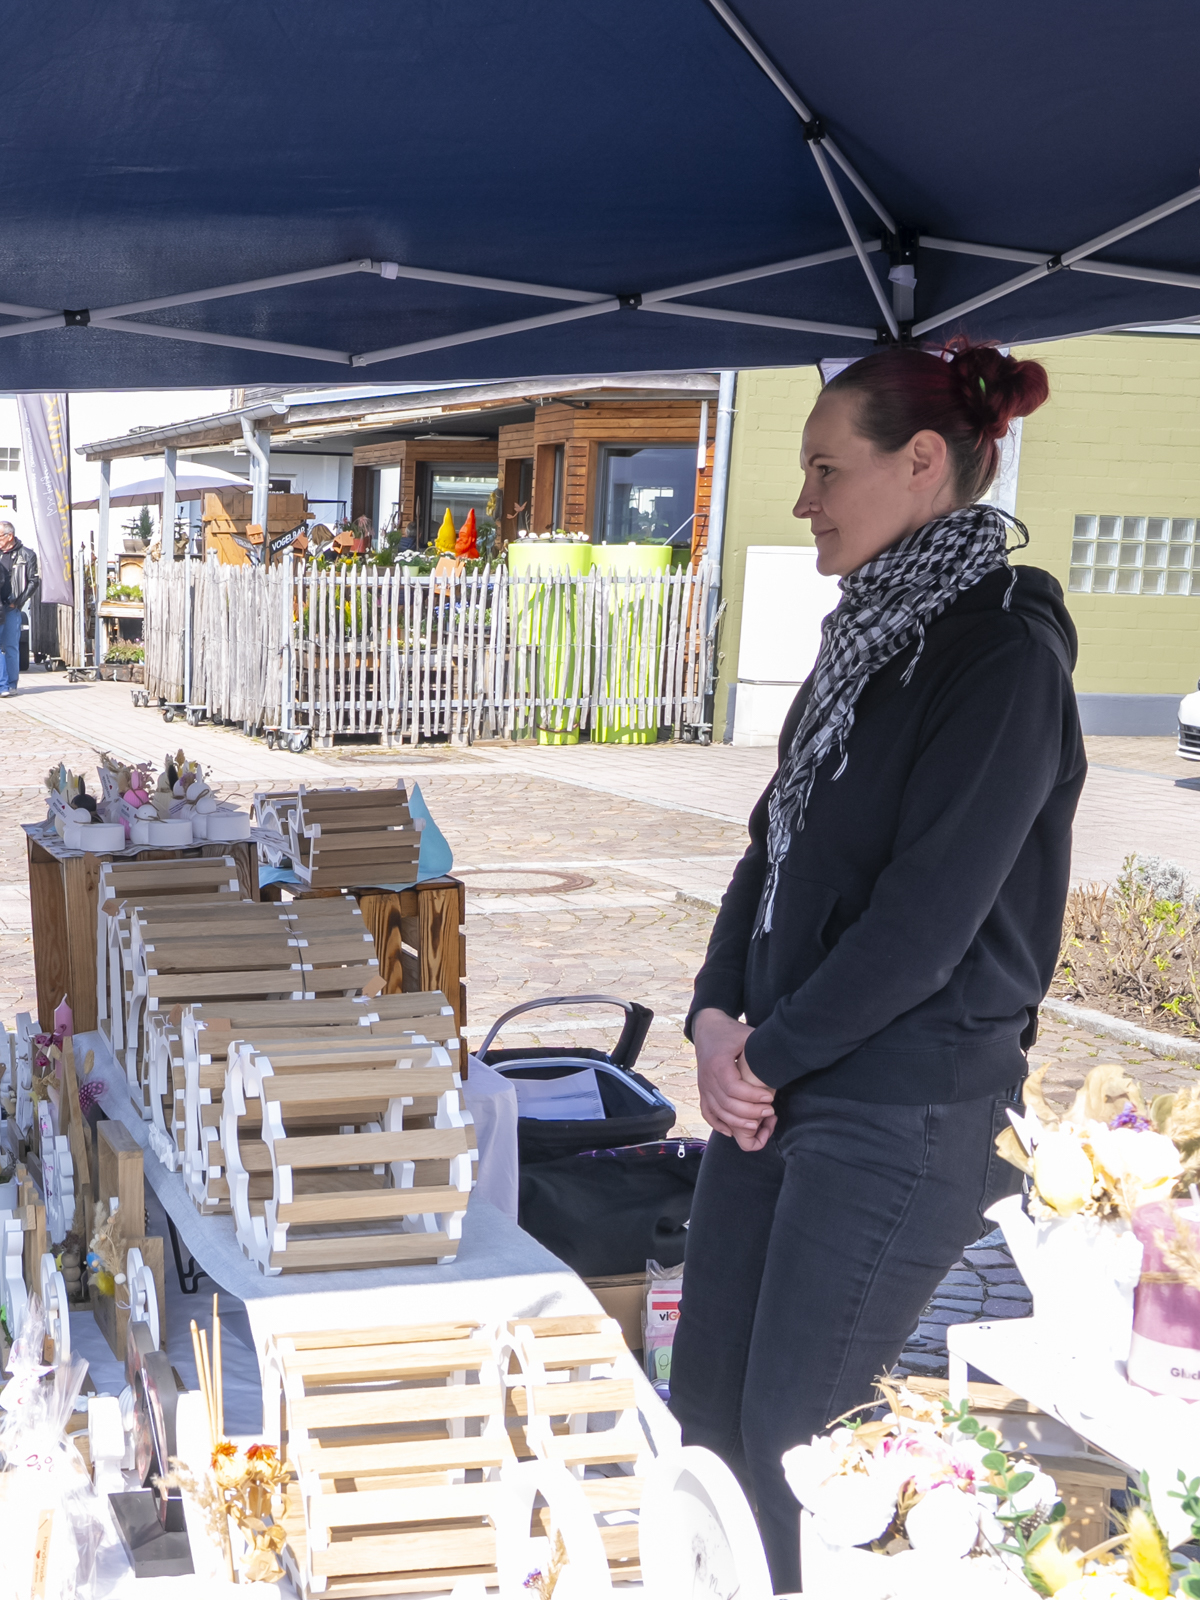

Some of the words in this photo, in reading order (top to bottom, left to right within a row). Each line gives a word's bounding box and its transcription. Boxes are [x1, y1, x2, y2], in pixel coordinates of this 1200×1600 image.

[271, 526, 306, 551] VOGELBAR
[659, 1311, 681, 1321] viG
[39, 1536, 49, 1583] Handmade
